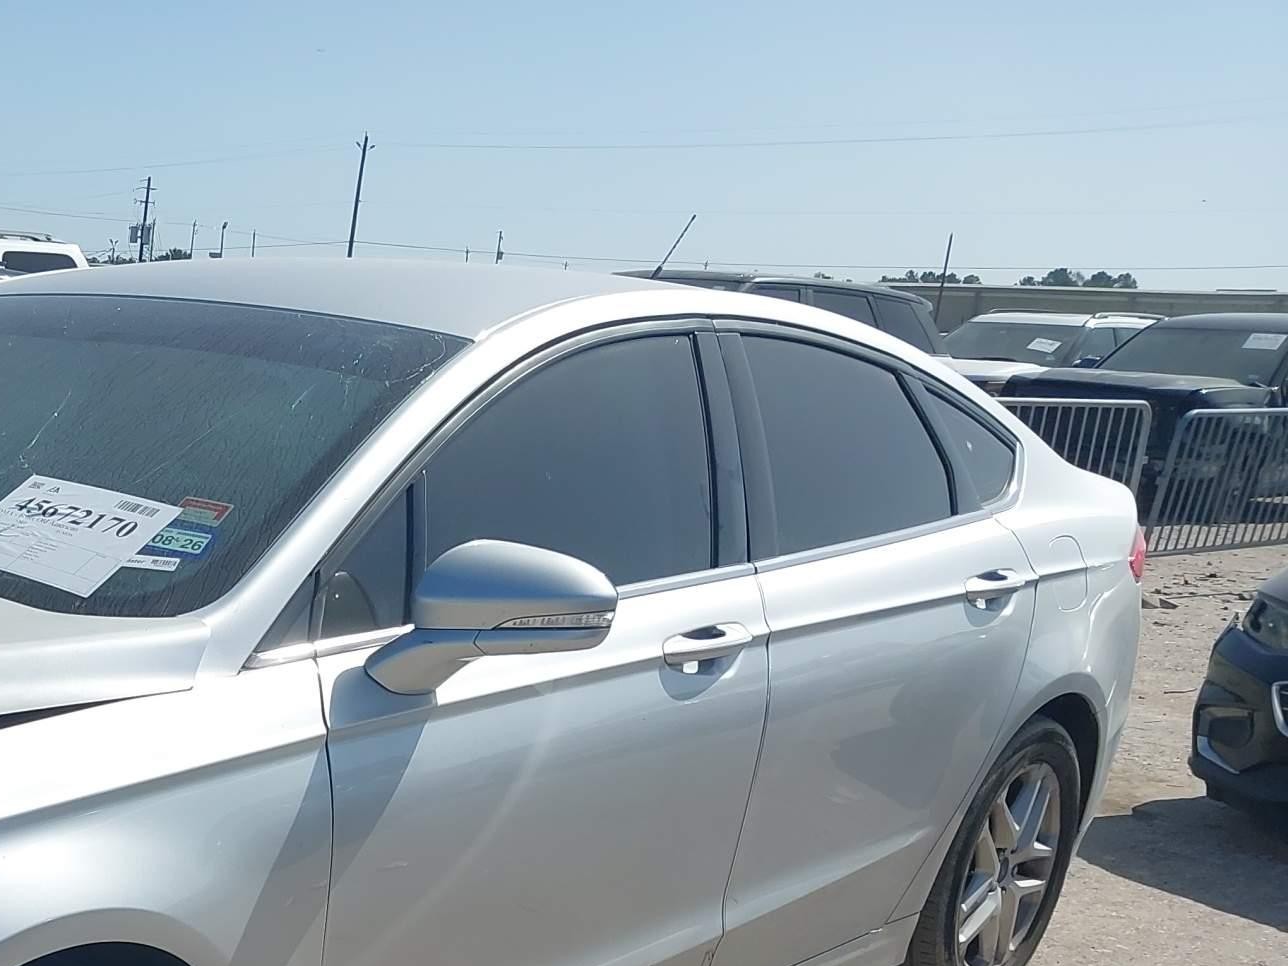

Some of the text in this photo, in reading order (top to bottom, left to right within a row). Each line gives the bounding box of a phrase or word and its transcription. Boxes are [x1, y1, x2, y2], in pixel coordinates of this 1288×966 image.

[14, 496, 139, 539] 45672170
[152, 533, 175, 547] 08
[180, 538, 205, 551] 26
